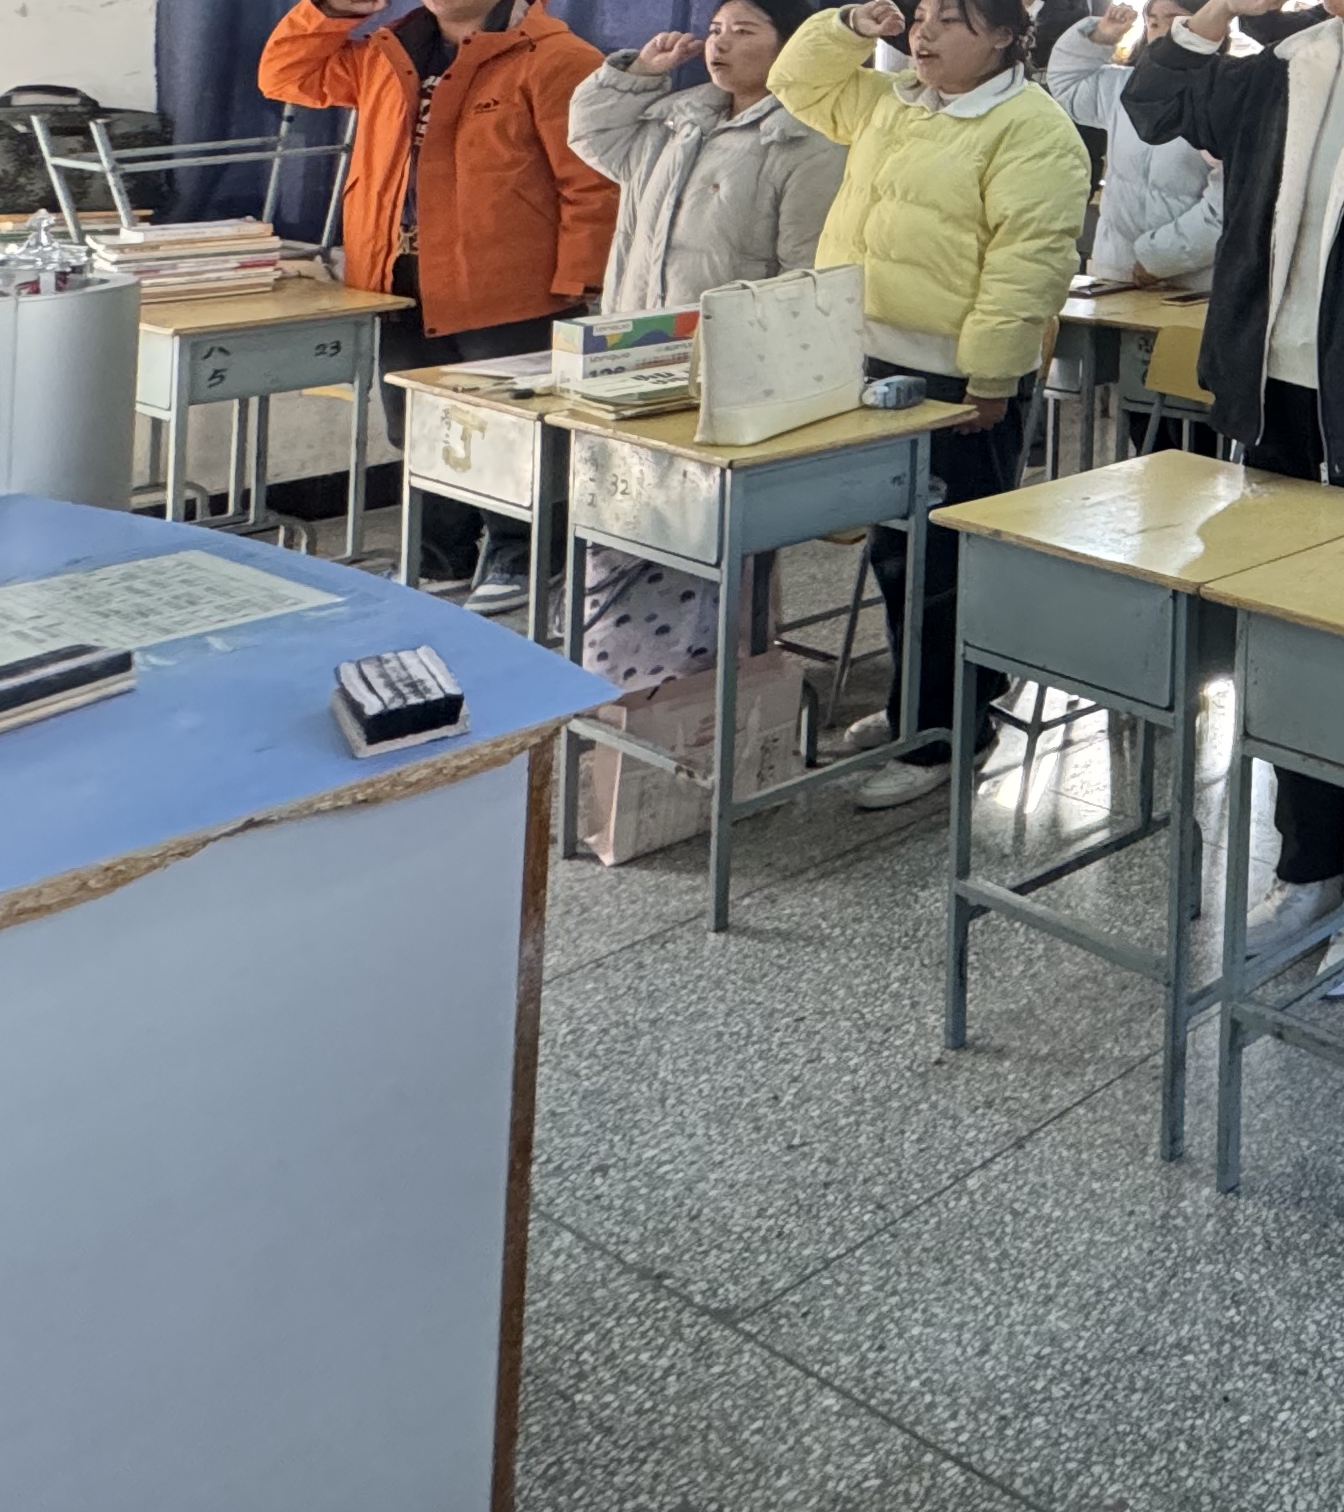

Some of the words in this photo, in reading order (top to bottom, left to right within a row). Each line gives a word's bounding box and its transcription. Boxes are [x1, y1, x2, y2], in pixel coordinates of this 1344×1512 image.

[314, 340, 342, 357] 23
[208, 368, 228, 388] 5
[609, 473, 631, 497] 32
